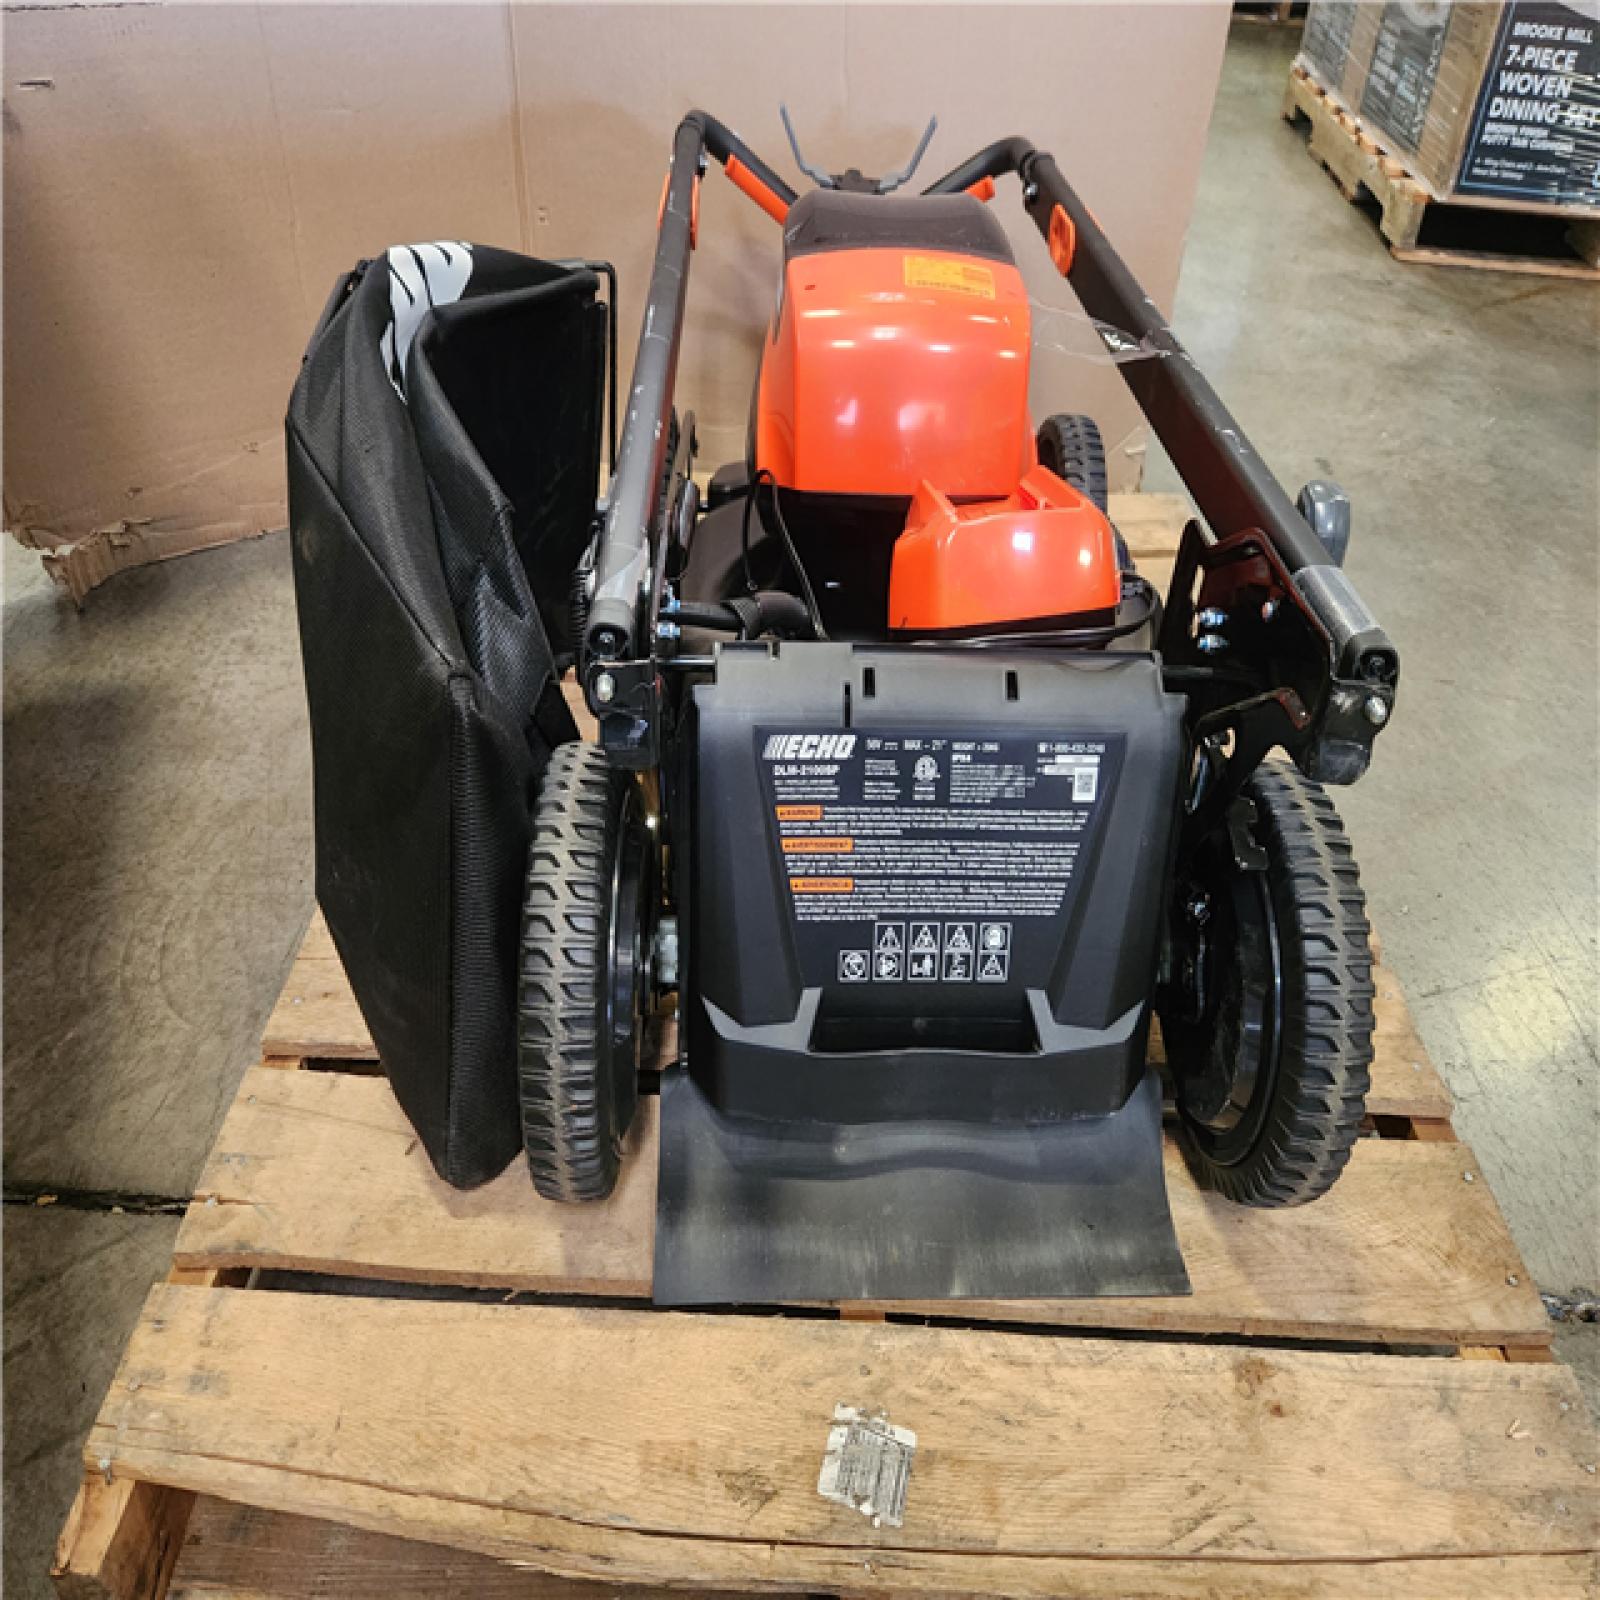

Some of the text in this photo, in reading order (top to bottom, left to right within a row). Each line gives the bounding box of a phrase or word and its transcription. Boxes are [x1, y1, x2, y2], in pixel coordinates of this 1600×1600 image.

[1513, 21, 1593, 44] BROOKE MILL
[1505, 44, 1578, 71] 7-PIECE
[1499, 71, 1573, 99] WOVEN
[1489, 97, 1560, 124] DINING
[780, 734, 856, 759] ECHO
